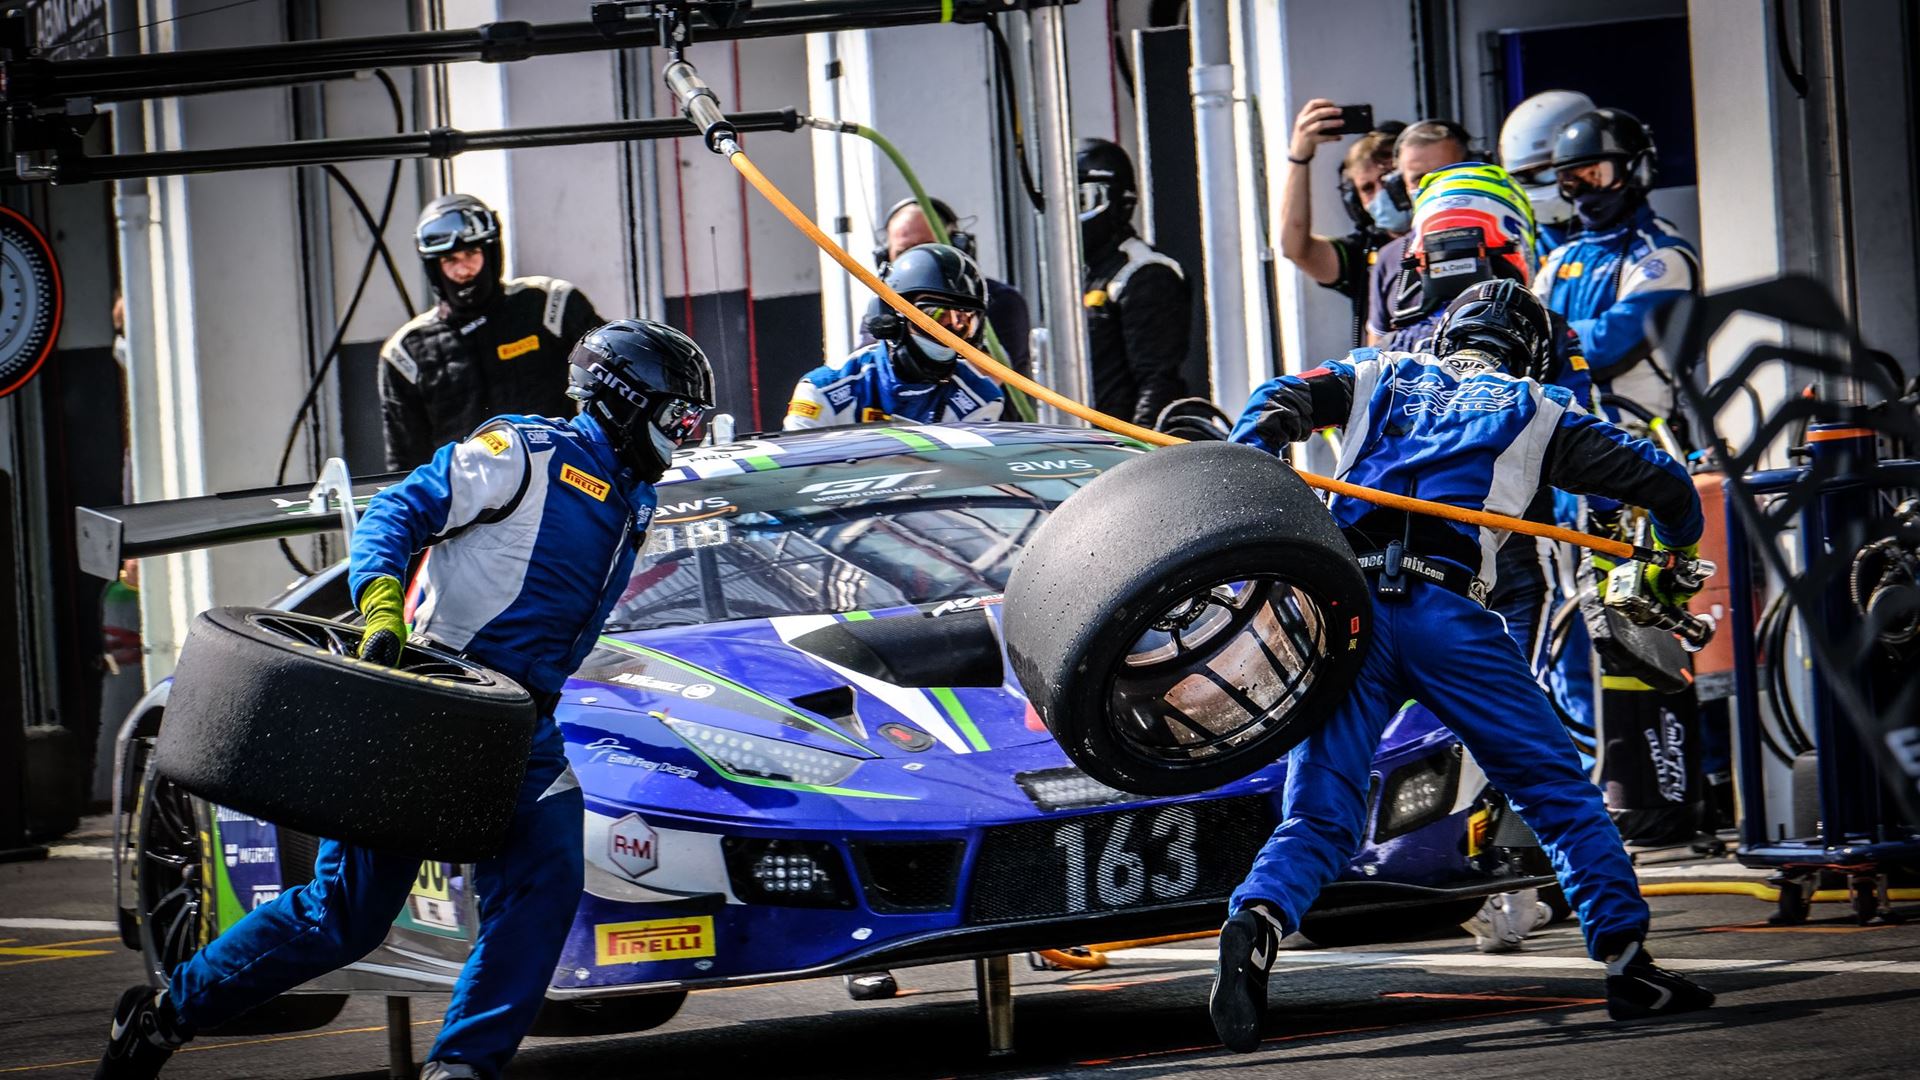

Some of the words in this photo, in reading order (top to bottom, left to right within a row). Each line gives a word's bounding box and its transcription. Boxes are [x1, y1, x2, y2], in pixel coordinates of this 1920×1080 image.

[588, 363, 648, 408] GIRO
[526, 431, 550, 443] OMP
[1008, 459, 1093, 472] aws
[566, 468, 605, 496] PIRELLI
[812, 490, 858, 502] WORLD
[862, 484, 937, 496] CHALLENGE
[1358, 553, 1445, 581] mecnix.com
[660, 762, 699, 778] Design
[614, 834, 651, 860] R-M
[1055, 805, 1199, 914] 163
[607, 924, 702, 957] PIRELLI
